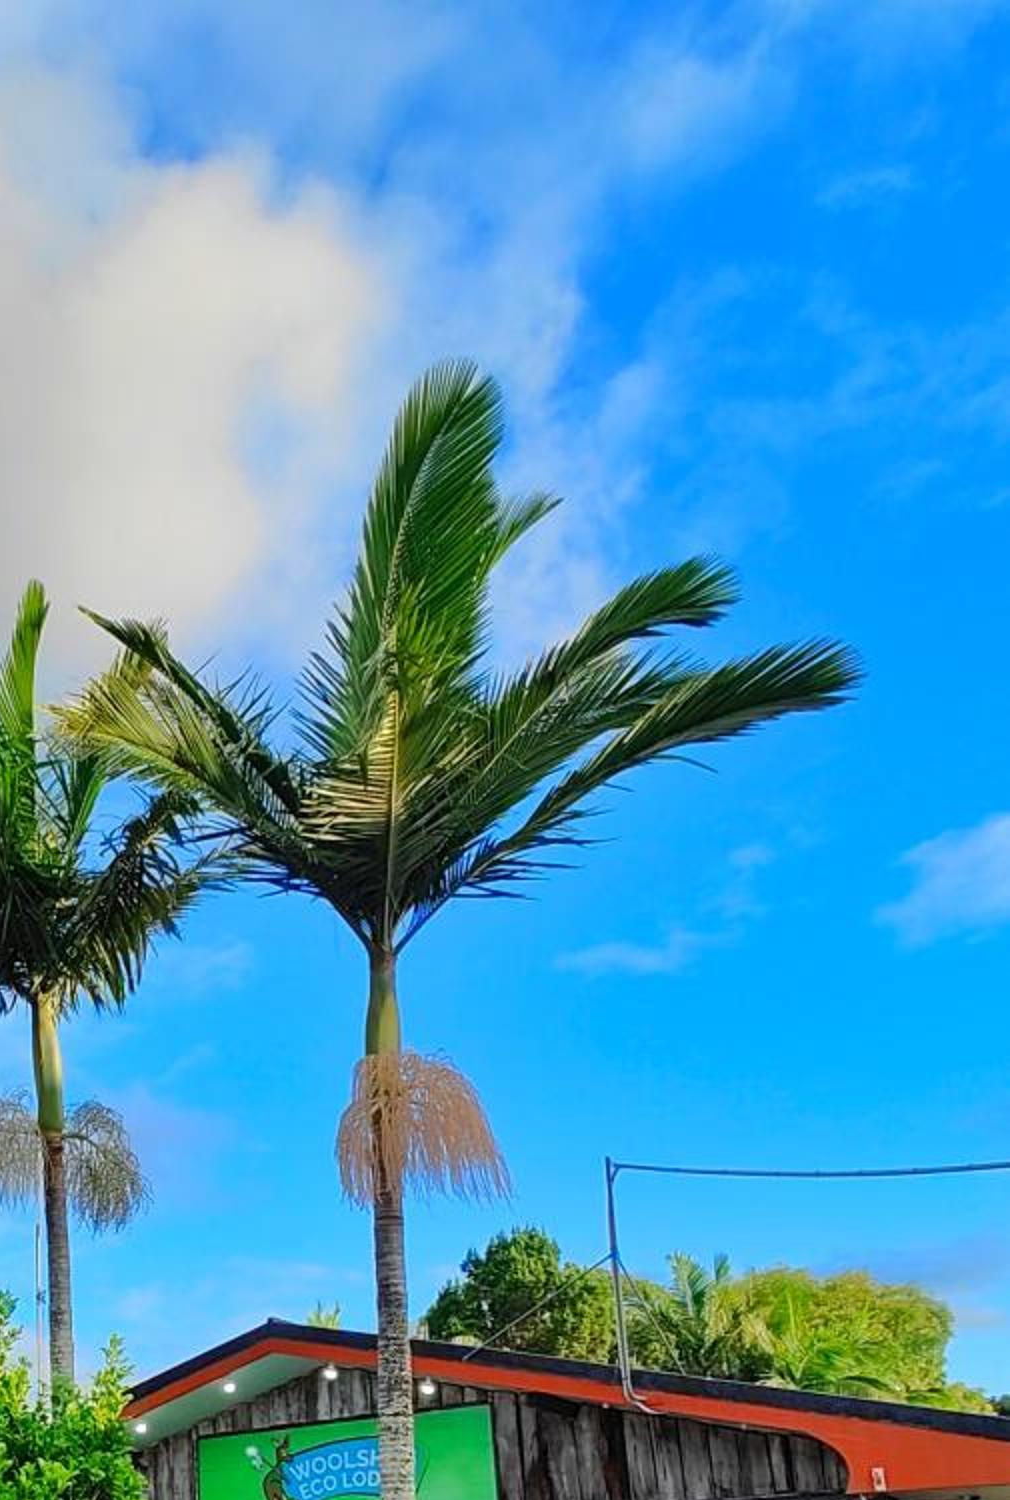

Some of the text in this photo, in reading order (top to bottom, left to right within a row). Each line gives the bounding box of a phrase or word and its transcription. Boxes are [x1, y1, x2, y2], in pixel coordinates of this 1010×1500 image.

[289, 1448, 381, 1481] WOOLSH
[299, 1470, 382, 1500] ECO LOD
